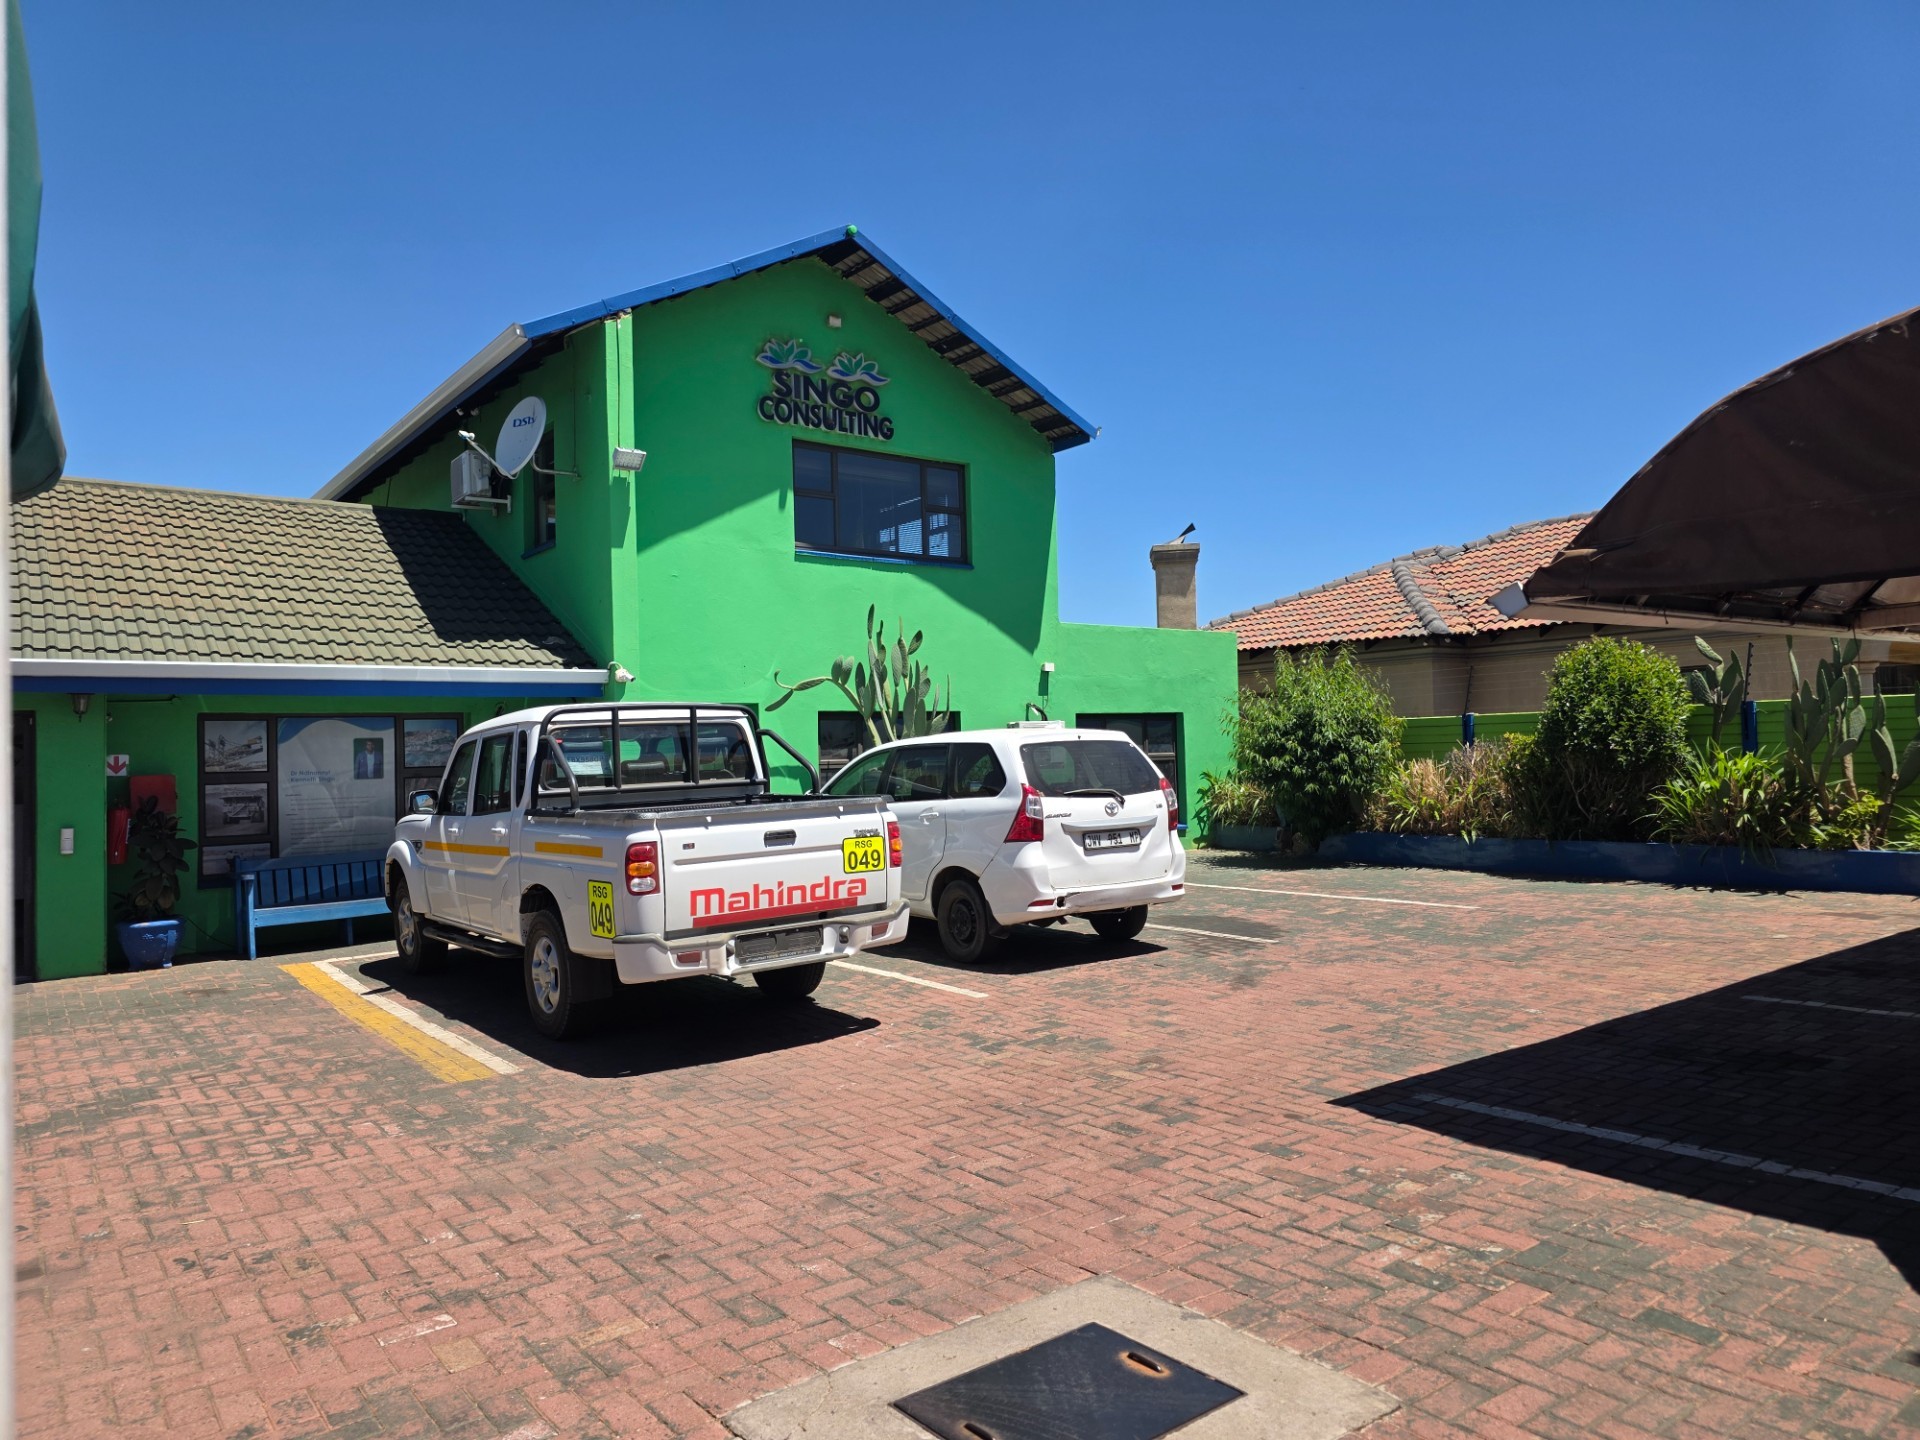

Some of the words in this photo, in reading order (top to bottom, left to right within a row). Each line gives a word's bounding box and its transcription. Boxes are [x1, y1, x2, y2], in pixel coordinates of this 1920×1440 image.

[773, 370, 880, 413] SINGO
[757, 396, 895, 440] CONSULTING
[854, 839, 873, 849] RSG
[1129, 831, 1139, 844] MP
[847, 849, 881, 871] 049
[592, 885, 608, 899] RSG
[591, 901, 613, 935] 049
